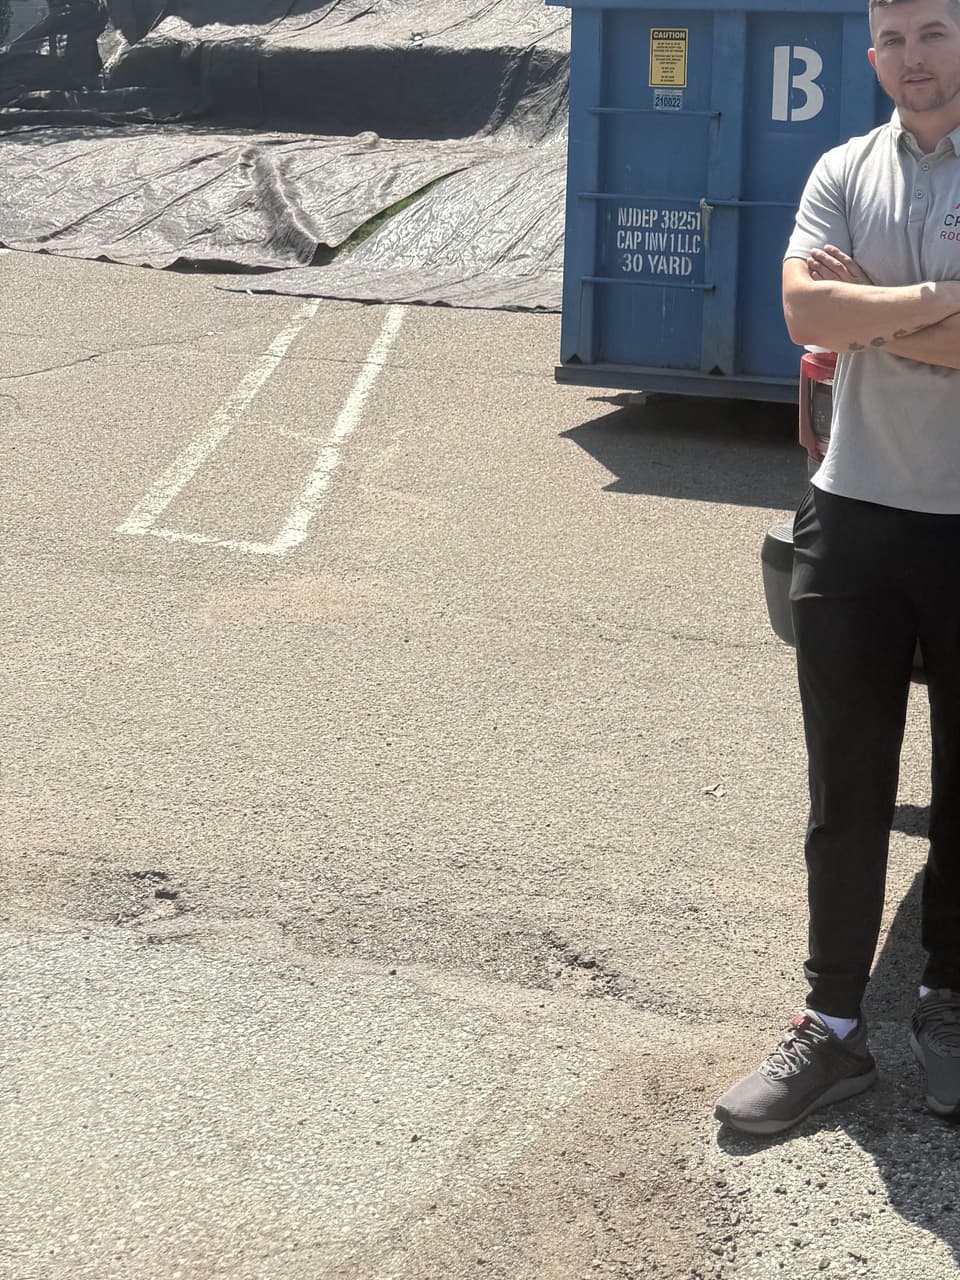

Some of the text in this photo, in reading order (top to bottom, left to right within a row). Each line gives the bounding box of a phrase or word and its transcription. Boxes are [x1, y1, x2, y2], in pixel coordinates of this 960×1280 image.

[653, 31, 686, 39] CAUTION
[617, 207, 701, 231] NJDEP 38251
[616, 230, 642, 250] CAP
[645, 231, 668, 252] INV
[622, 253, 693, 276] 30 YARD
